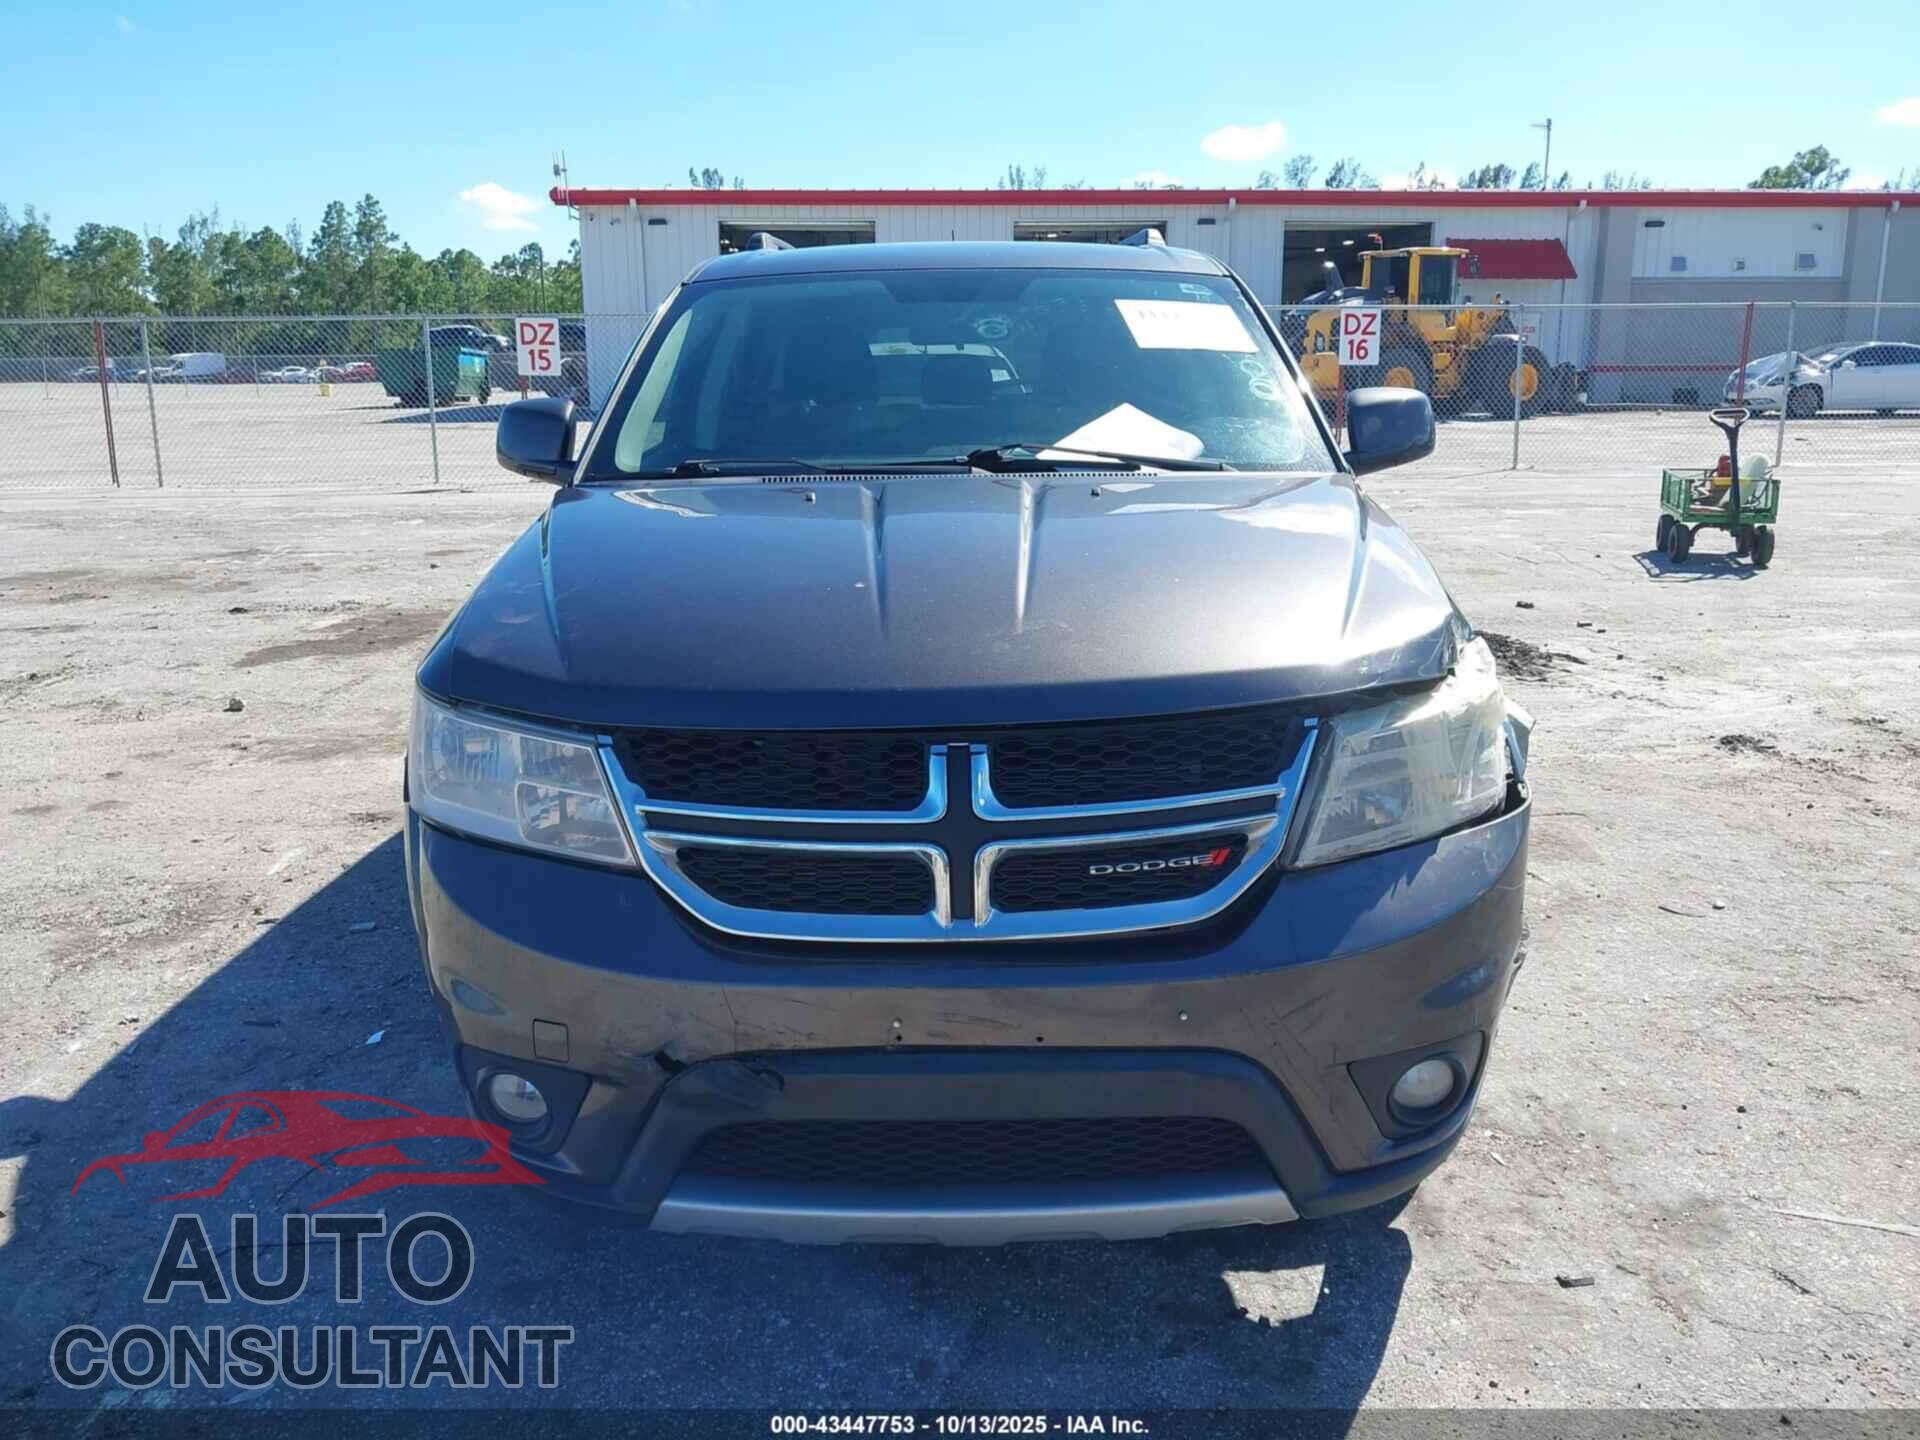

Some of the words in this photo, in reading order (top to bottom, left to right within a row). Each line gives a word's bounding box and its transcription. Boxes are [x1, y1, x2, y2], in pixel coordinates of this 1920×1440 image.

[519, 322, 556, 345] DZ
[1344, 313, 1377, 335] DZ
[528, 350, 552, 371] 15
[1347, 339, 1369, 360] 16
[1089, 853, 1213, 875] DODGE
